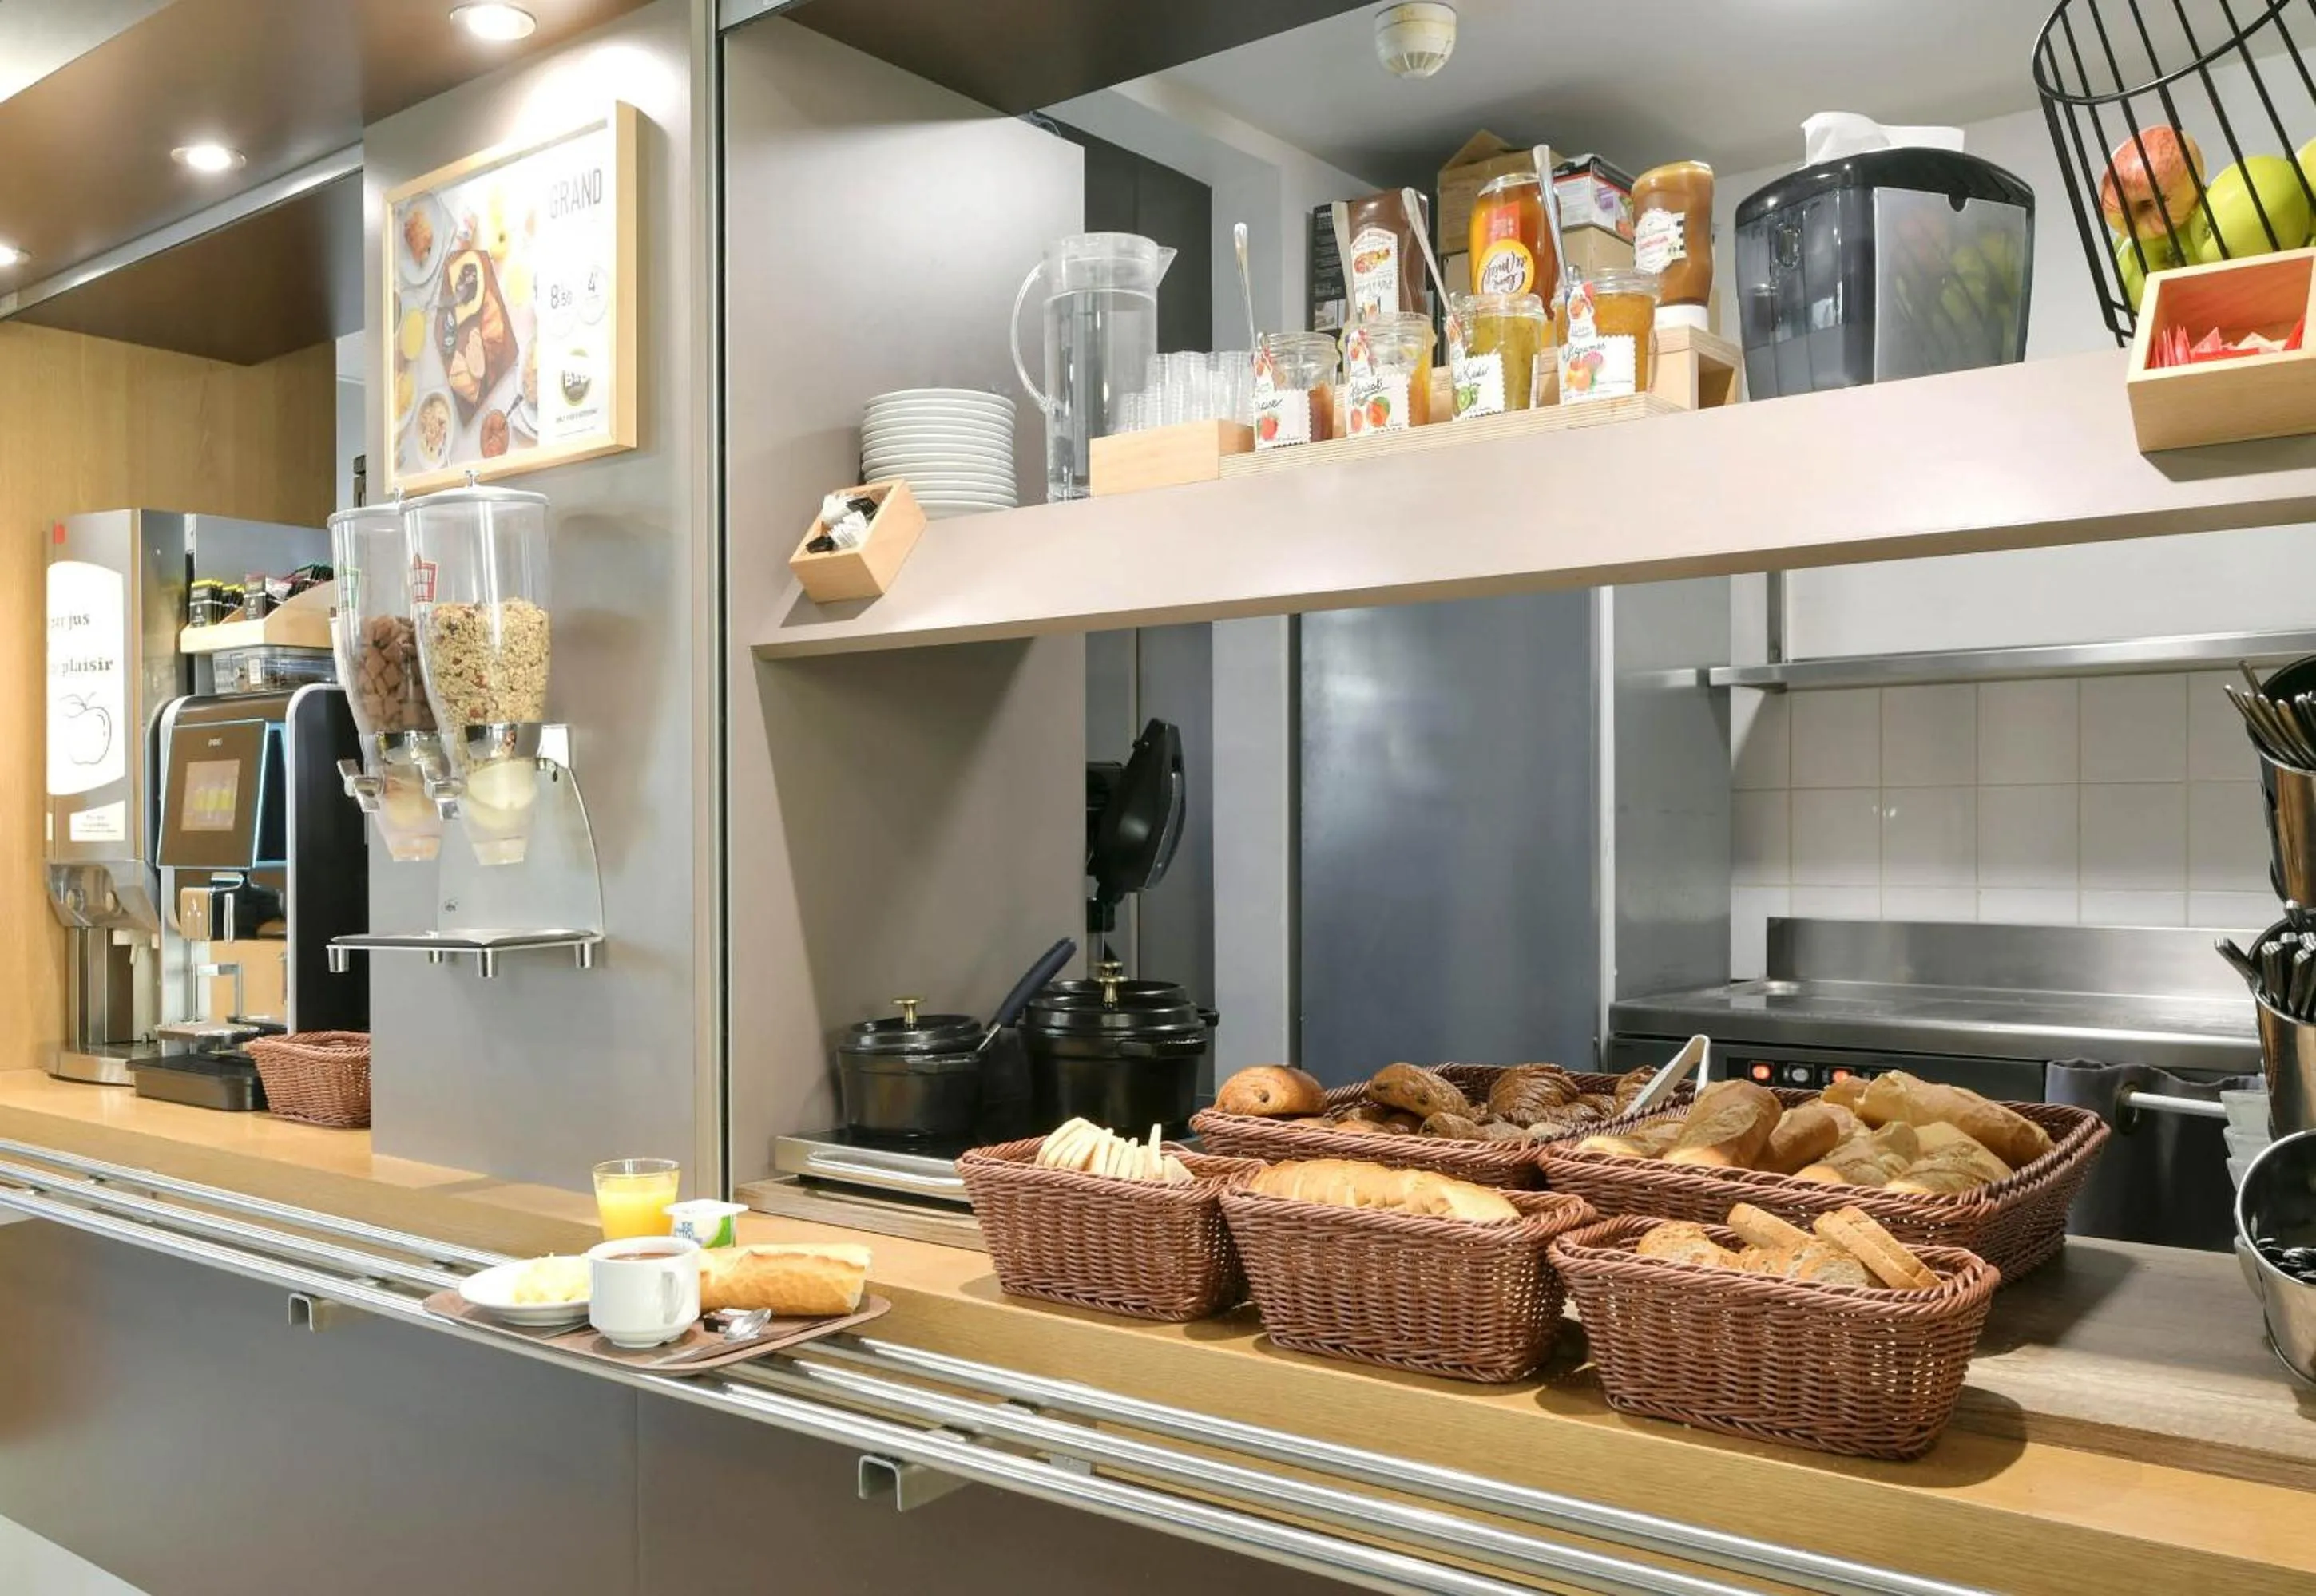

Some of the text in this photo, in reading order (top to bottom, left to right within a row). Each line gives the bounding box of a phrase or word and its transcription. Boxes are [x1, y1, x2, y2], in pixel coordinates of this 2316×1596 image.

[549, 168, 602, 220] GRAND
[68, 611, 91, 631] jus
[61, 657, 113, 678] plaisir
